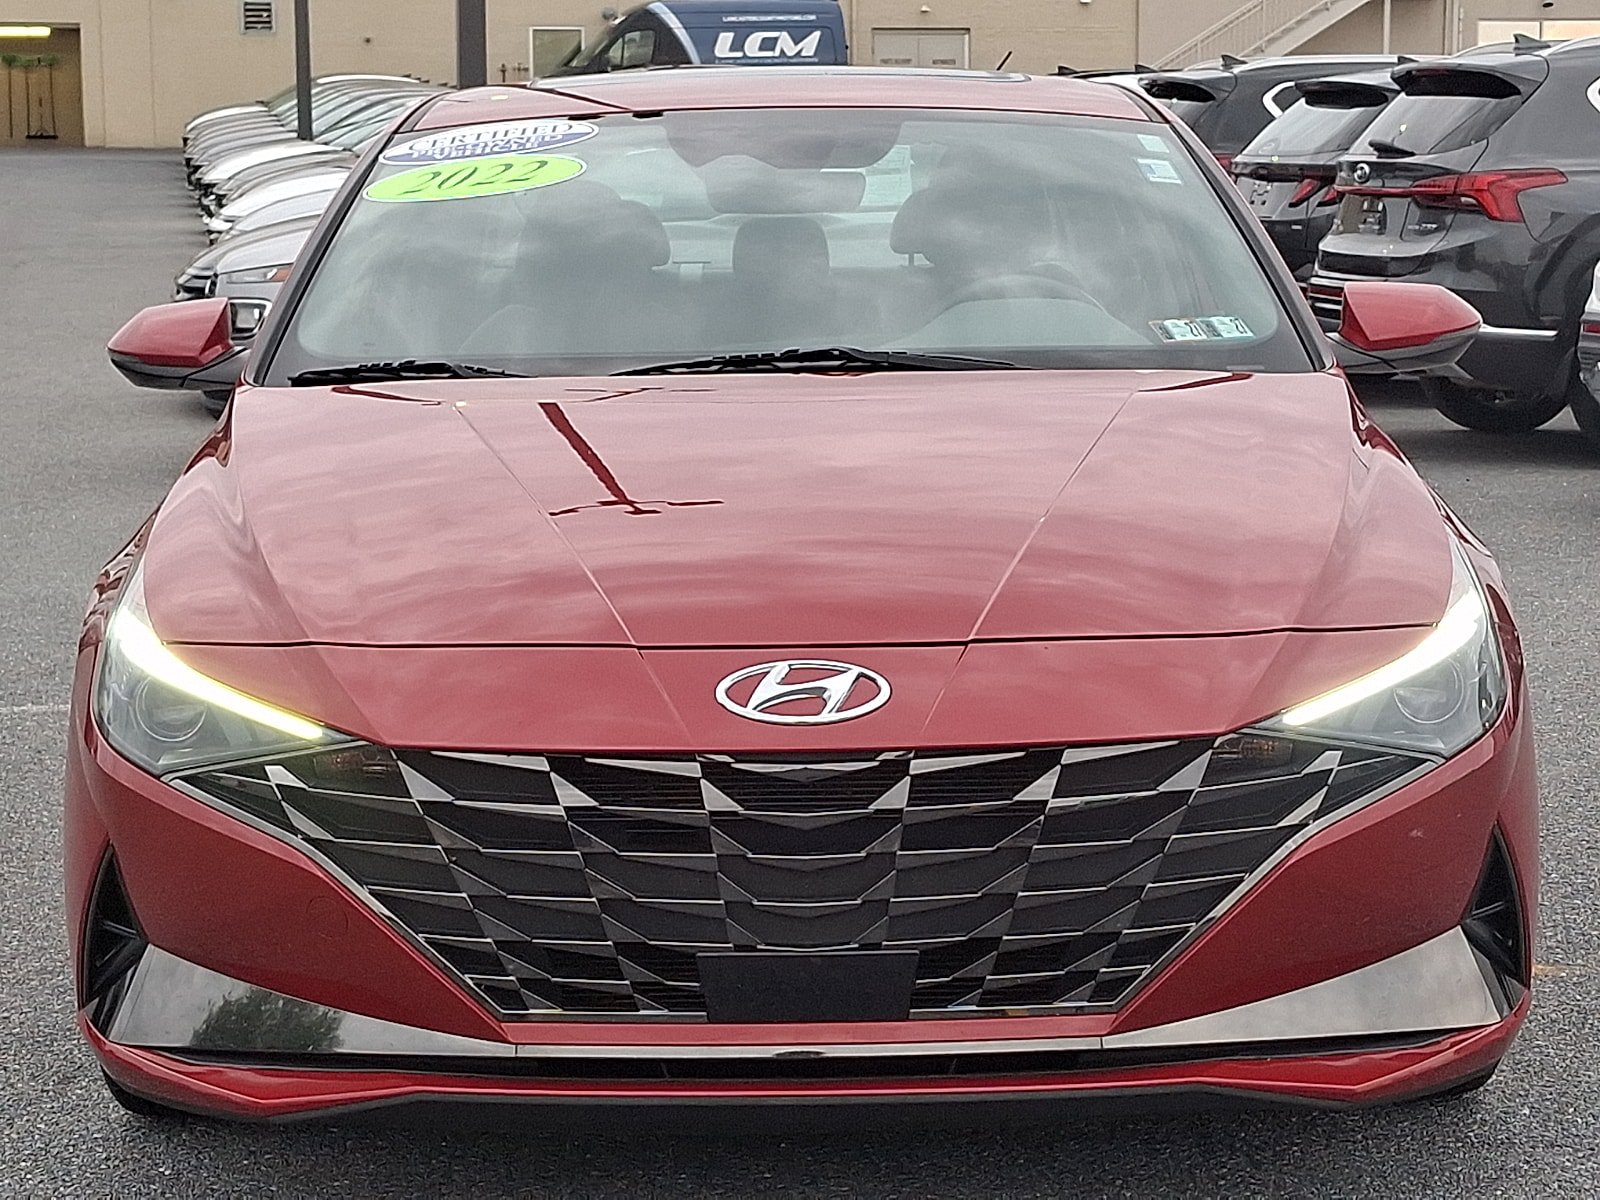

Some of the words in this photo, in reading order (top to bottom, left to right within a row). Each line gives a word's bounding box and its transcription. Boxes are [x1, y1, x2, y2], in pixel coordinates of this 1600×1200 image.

[714, 30, 822, 58] LCM
[408, 123, 572, 151] CERTIFIED
[397, 160, 549, 196] 2022
